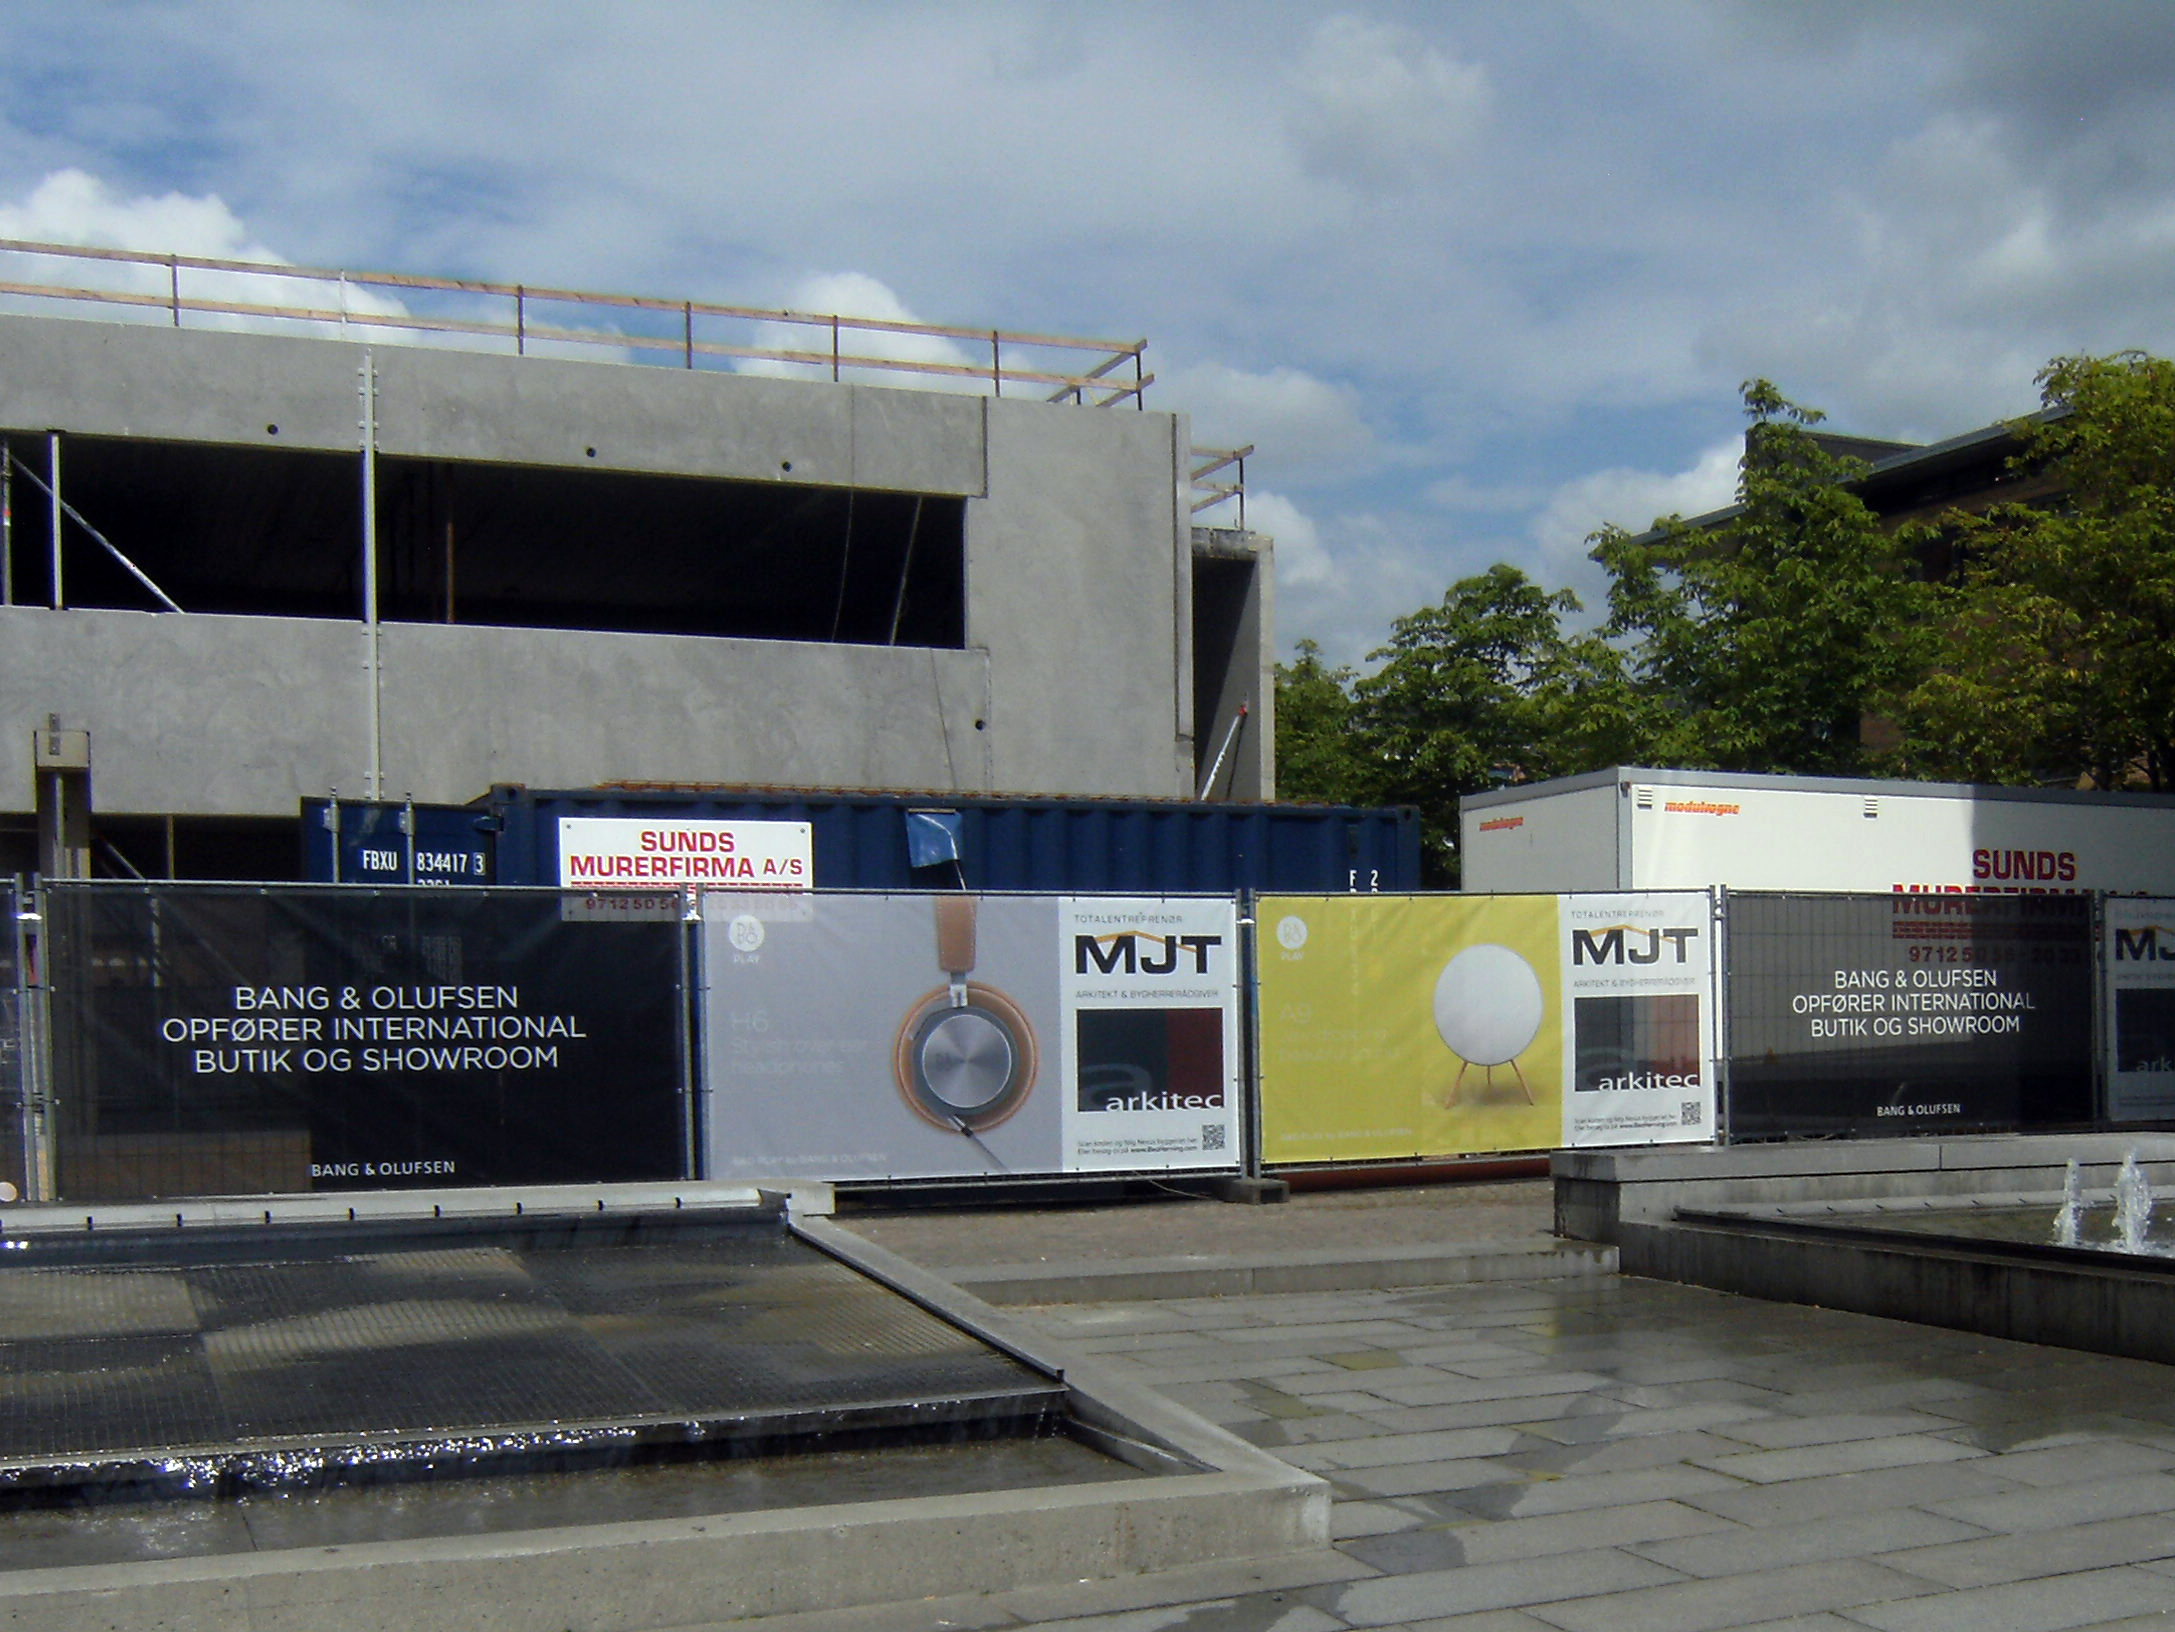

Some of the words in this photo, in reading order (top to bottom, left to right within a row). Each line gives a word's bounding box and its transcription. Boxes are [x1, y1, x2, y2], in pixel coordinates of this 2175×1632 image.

[641, 831, 735, 852] SUNDS
[362, 850, 398, 871] FBXU
[416, 852, 468, 873] 834417
[570, 856, 755, 877] MURERFIRMA
[763, 858, 803, 876] A/S
[1972, 850, 2076, 881] SUNDS
[1075, 934, 1222, 974] MJT
[1572, 928, 1698, 965] MJT
[1834, 970, 1889, 989] BANG
[1895, 970, 1908, 988] &
[1912, 969, 1997, 988] OLUFSEN
[235, 986, 329, 1010] BANG
[340, 986, 361, 1010] &
[371, 985, 518, 1010] OLUFSEN
[1792, 993, 1885, 1014] OPFØRER
[1891, 992, 2036, 1012] INTERNATIONAL
[162, 1018, 322, 1043] OPFØRER
[334, 1015, 587, 1041] INTERNATIONAL
[1811, 1018, 1868, 1037] BUTIK
[1873, 1017, 1902, 1036] OG
[1907, 1015, 2020, 1036] SHOWROOM
[195, 1049, 293, 1074] BUTIK
[303, 1048, 352, 1072] OG
[362, 1046, 558, 1072] SHOWROOM
[1599, 1072, 1699, 1091] arkitec
[1105, 1091, 1222, 1111] arkitec
[1876, 1105, 1905, 1117] BANG
[1907, 1105, 1914, 1115] &
[1916, 1103, 1961, 1115] OLUFSEN
[311, 1163, 359, 1177] BANG
[365, 1162, 376, 1175] &
[379, 1160, 456, 1176] OLUFSEN
